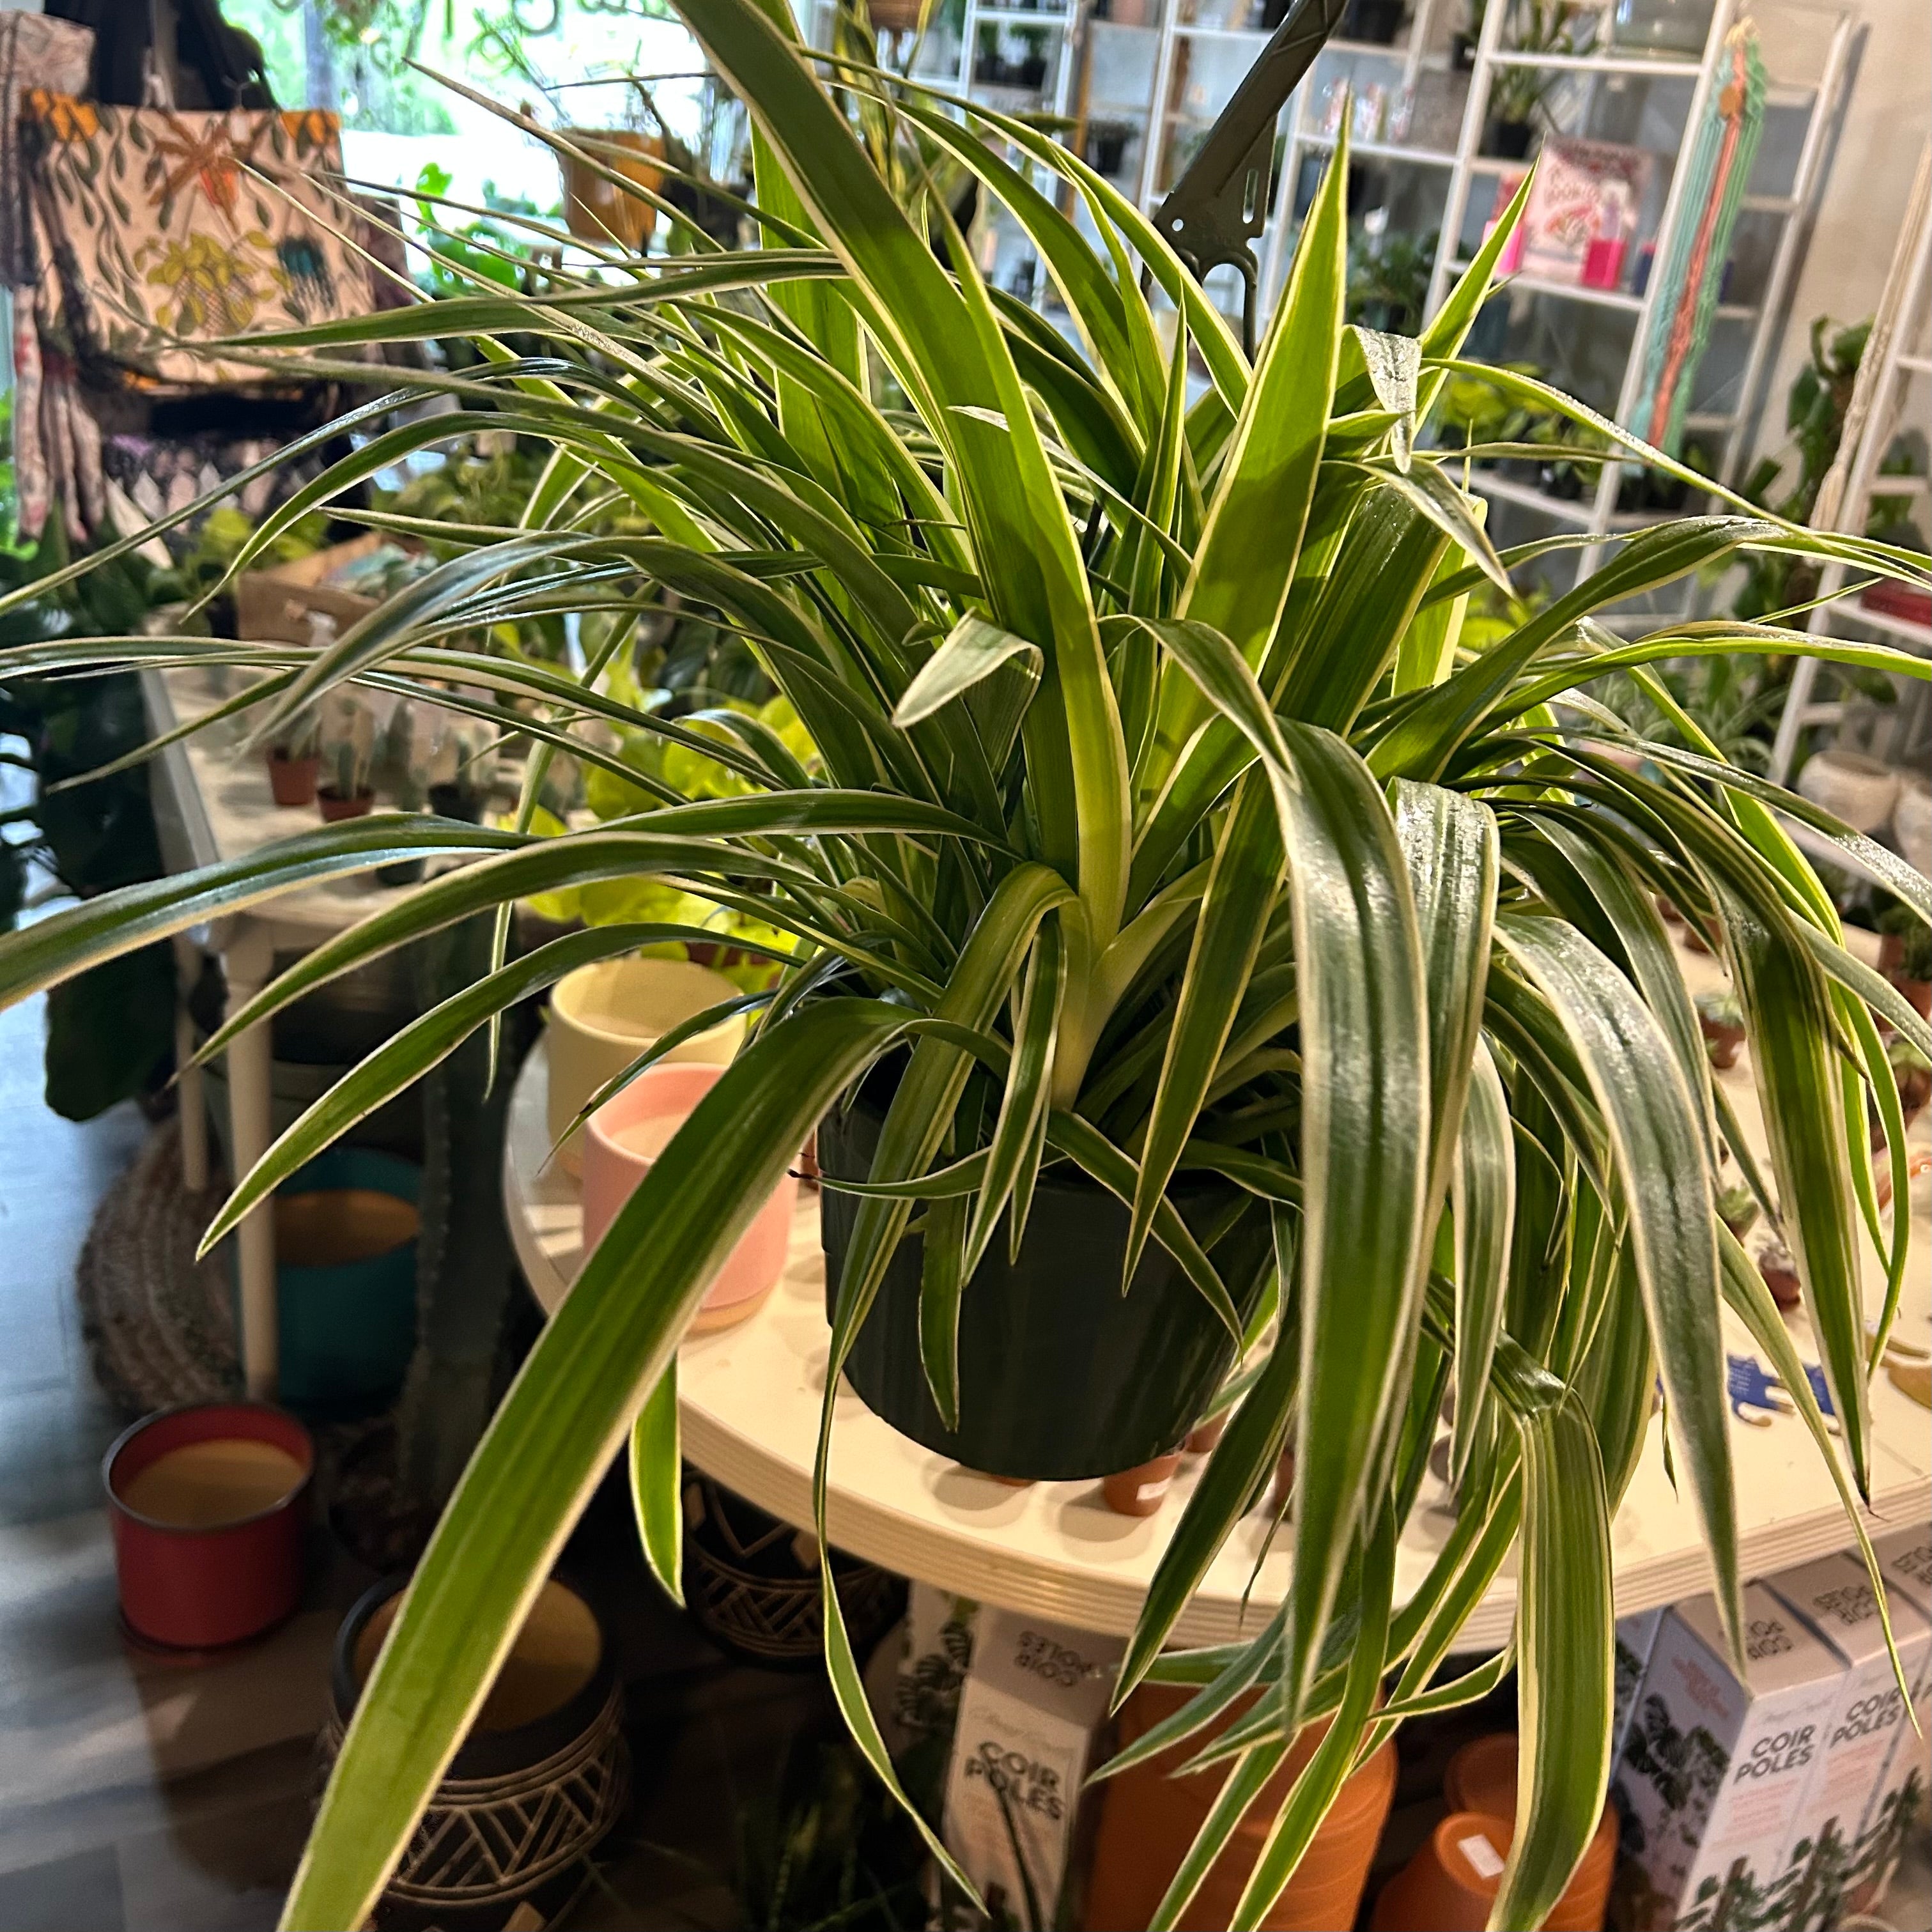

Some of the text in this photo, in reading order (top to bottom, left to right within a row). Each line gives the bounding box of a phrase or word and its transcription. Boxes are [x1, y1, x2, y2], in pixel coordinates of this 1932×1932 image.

[1846, 1687, 1901, 1722] COIR
[1751, 1724, 1816, 1759] COIR
[1829, 1704, 1901, 1749] POLES
[979, 1740, 1061, 1788] COIR
[1735, 1745, 1815, 1784] POLES
[964, 1756, 1062, 1820] POLES
